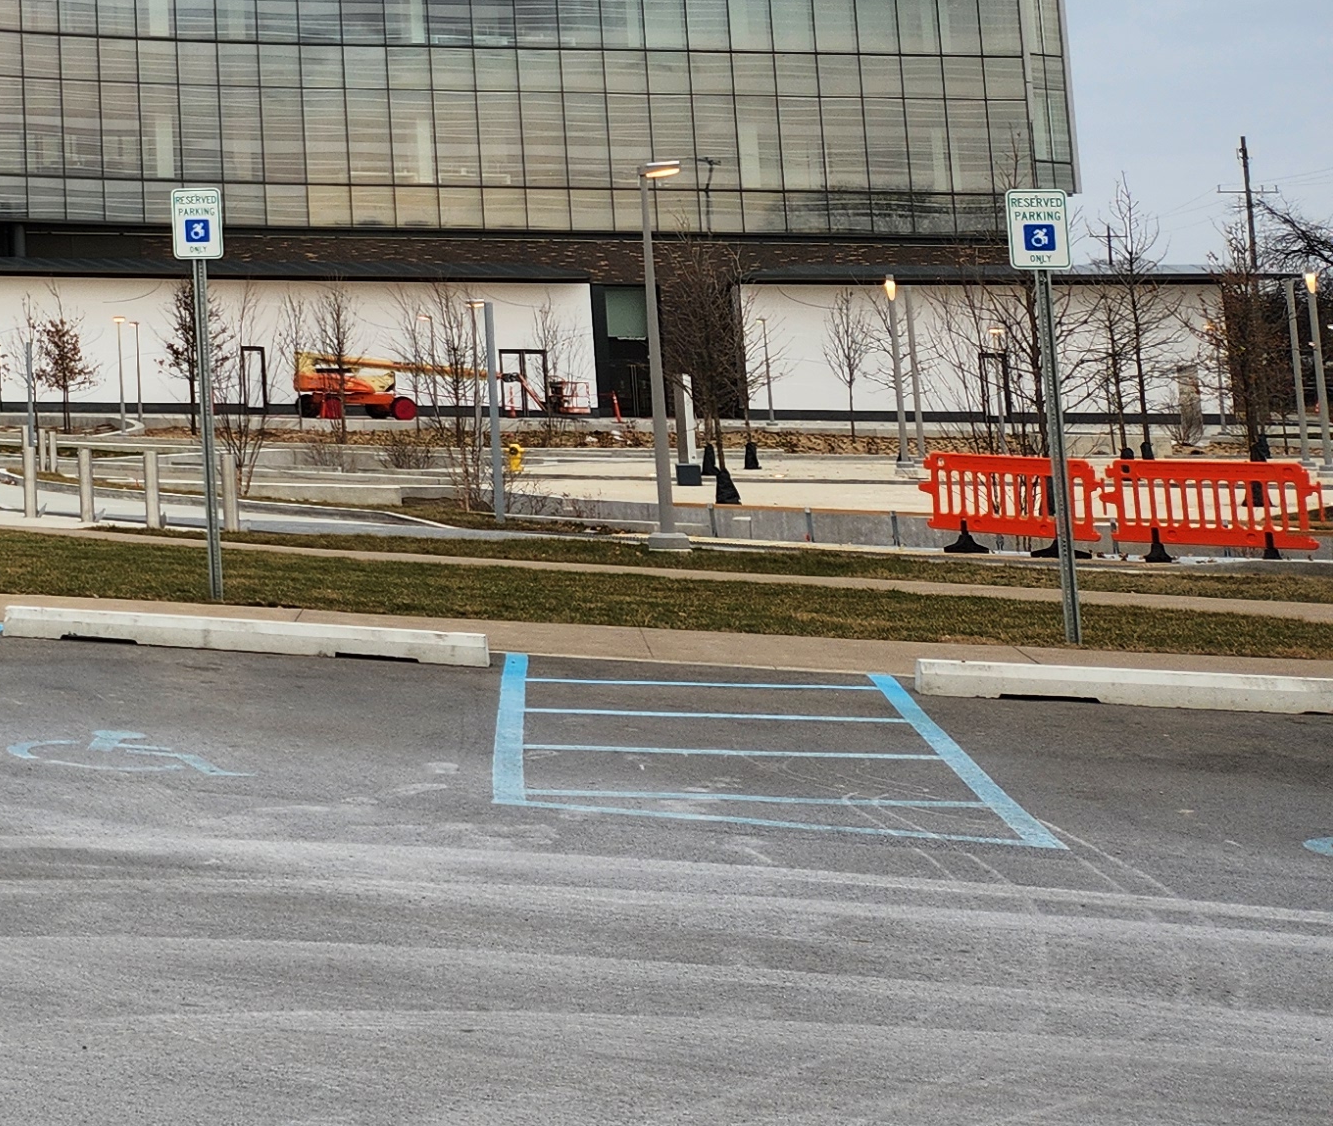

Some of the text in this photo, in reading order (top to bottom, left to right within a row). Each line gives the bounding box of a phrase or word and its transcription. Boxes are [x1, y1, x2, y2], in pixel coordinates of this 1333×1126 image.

[175, 195, 217, 205] RESERVED
[1011, 197, 1063, 207] RESERVED
[178, 207, 215, 216] PARKING
[1014, 211, 1061, 221] PARKING
[1030, 255, 1052, 263] ONLY
